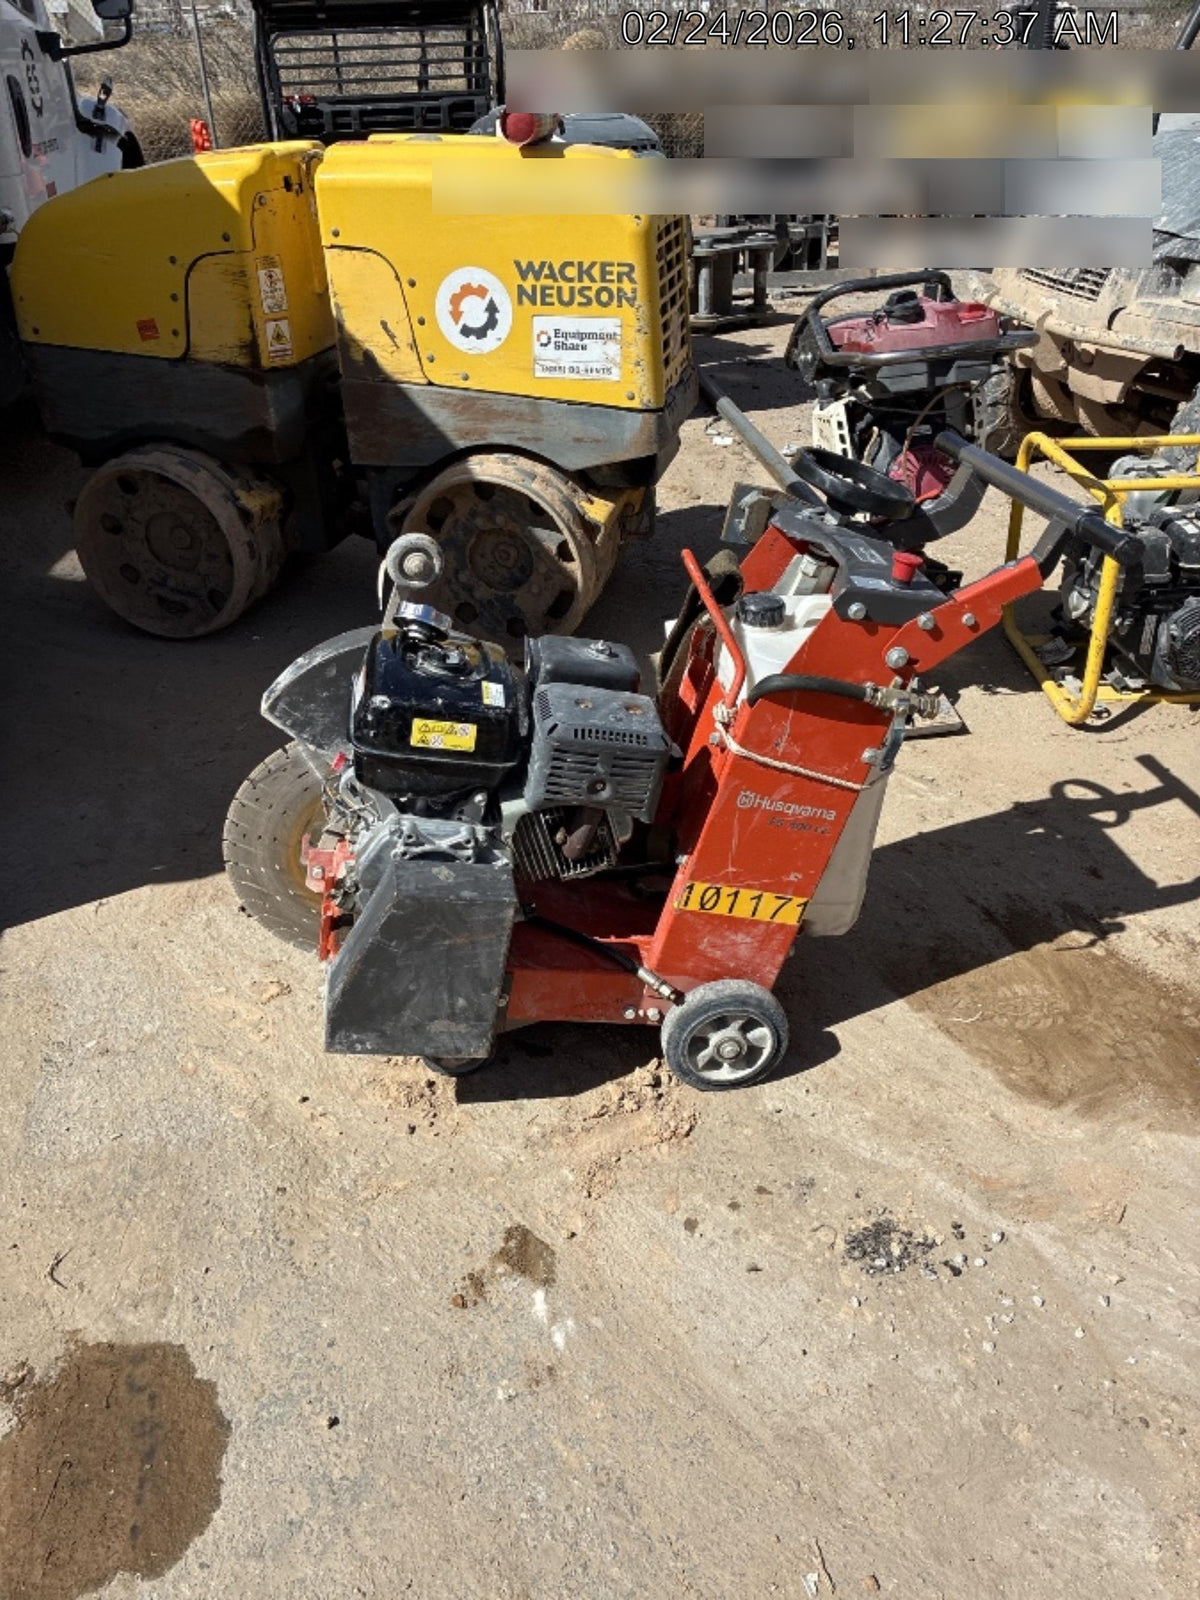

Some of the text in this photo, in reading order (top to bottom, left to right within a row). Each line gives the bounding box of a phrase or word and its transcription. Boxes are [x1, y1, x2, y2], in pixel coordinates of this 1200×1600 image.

[513, 260, 638, 284] WACKER
[516, 284, 638, 309] NEUSON
[553, 328, 618, 343] Equipment
[553, 341, 588, 351] Share
[753, 795, 837, 821] Husqvarna
[682, 882, 810, 924] 101171
